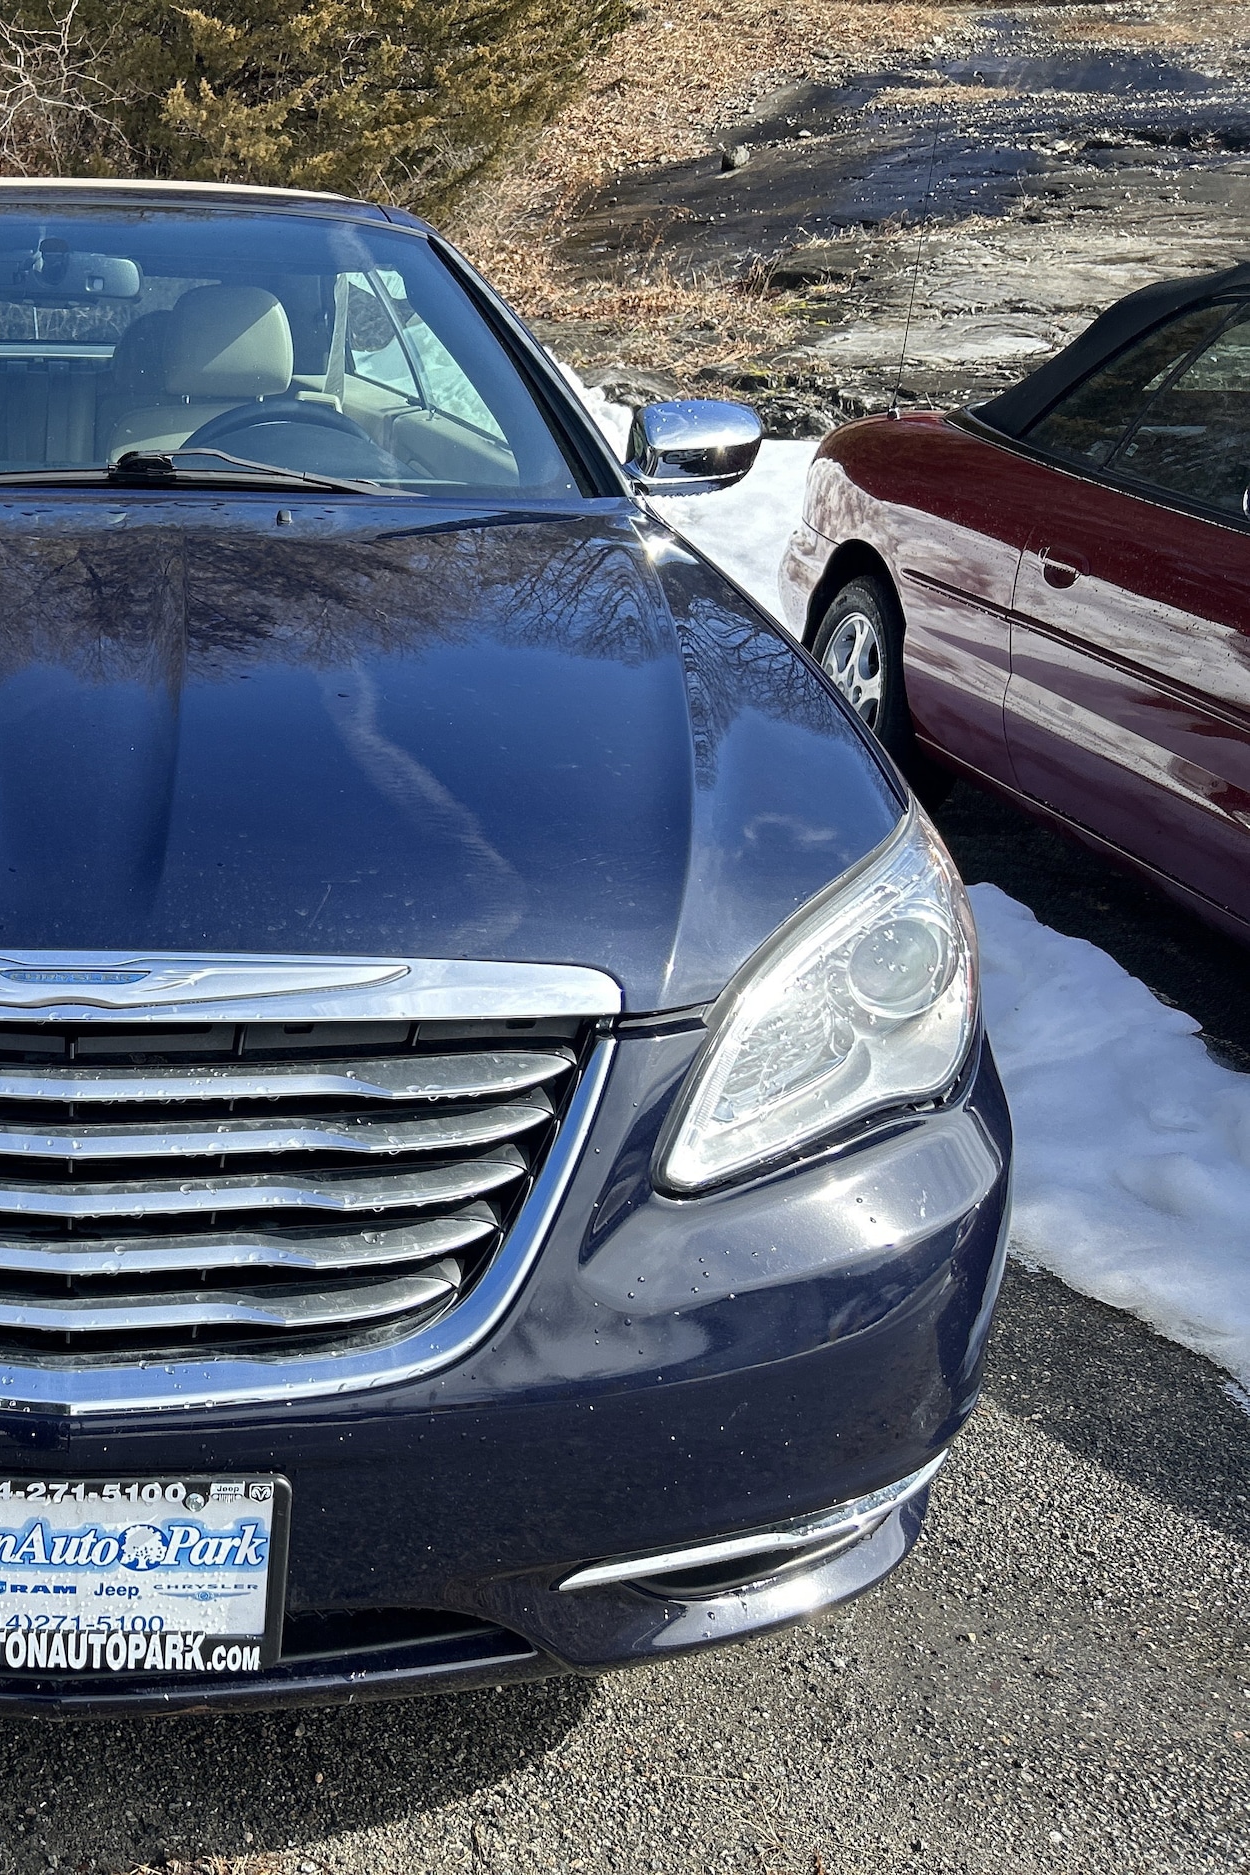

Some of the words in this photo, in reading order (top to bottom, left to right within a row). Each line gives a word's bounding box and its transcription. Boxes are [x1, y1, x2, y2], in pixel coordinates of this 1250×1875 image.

[216, 1485, 240, 1494] Jeep
[161, 1523, 268, 1566] Park
[10, 1584, 77, 1594] RAM
[93, 1582, 140, 1600] Jeep
